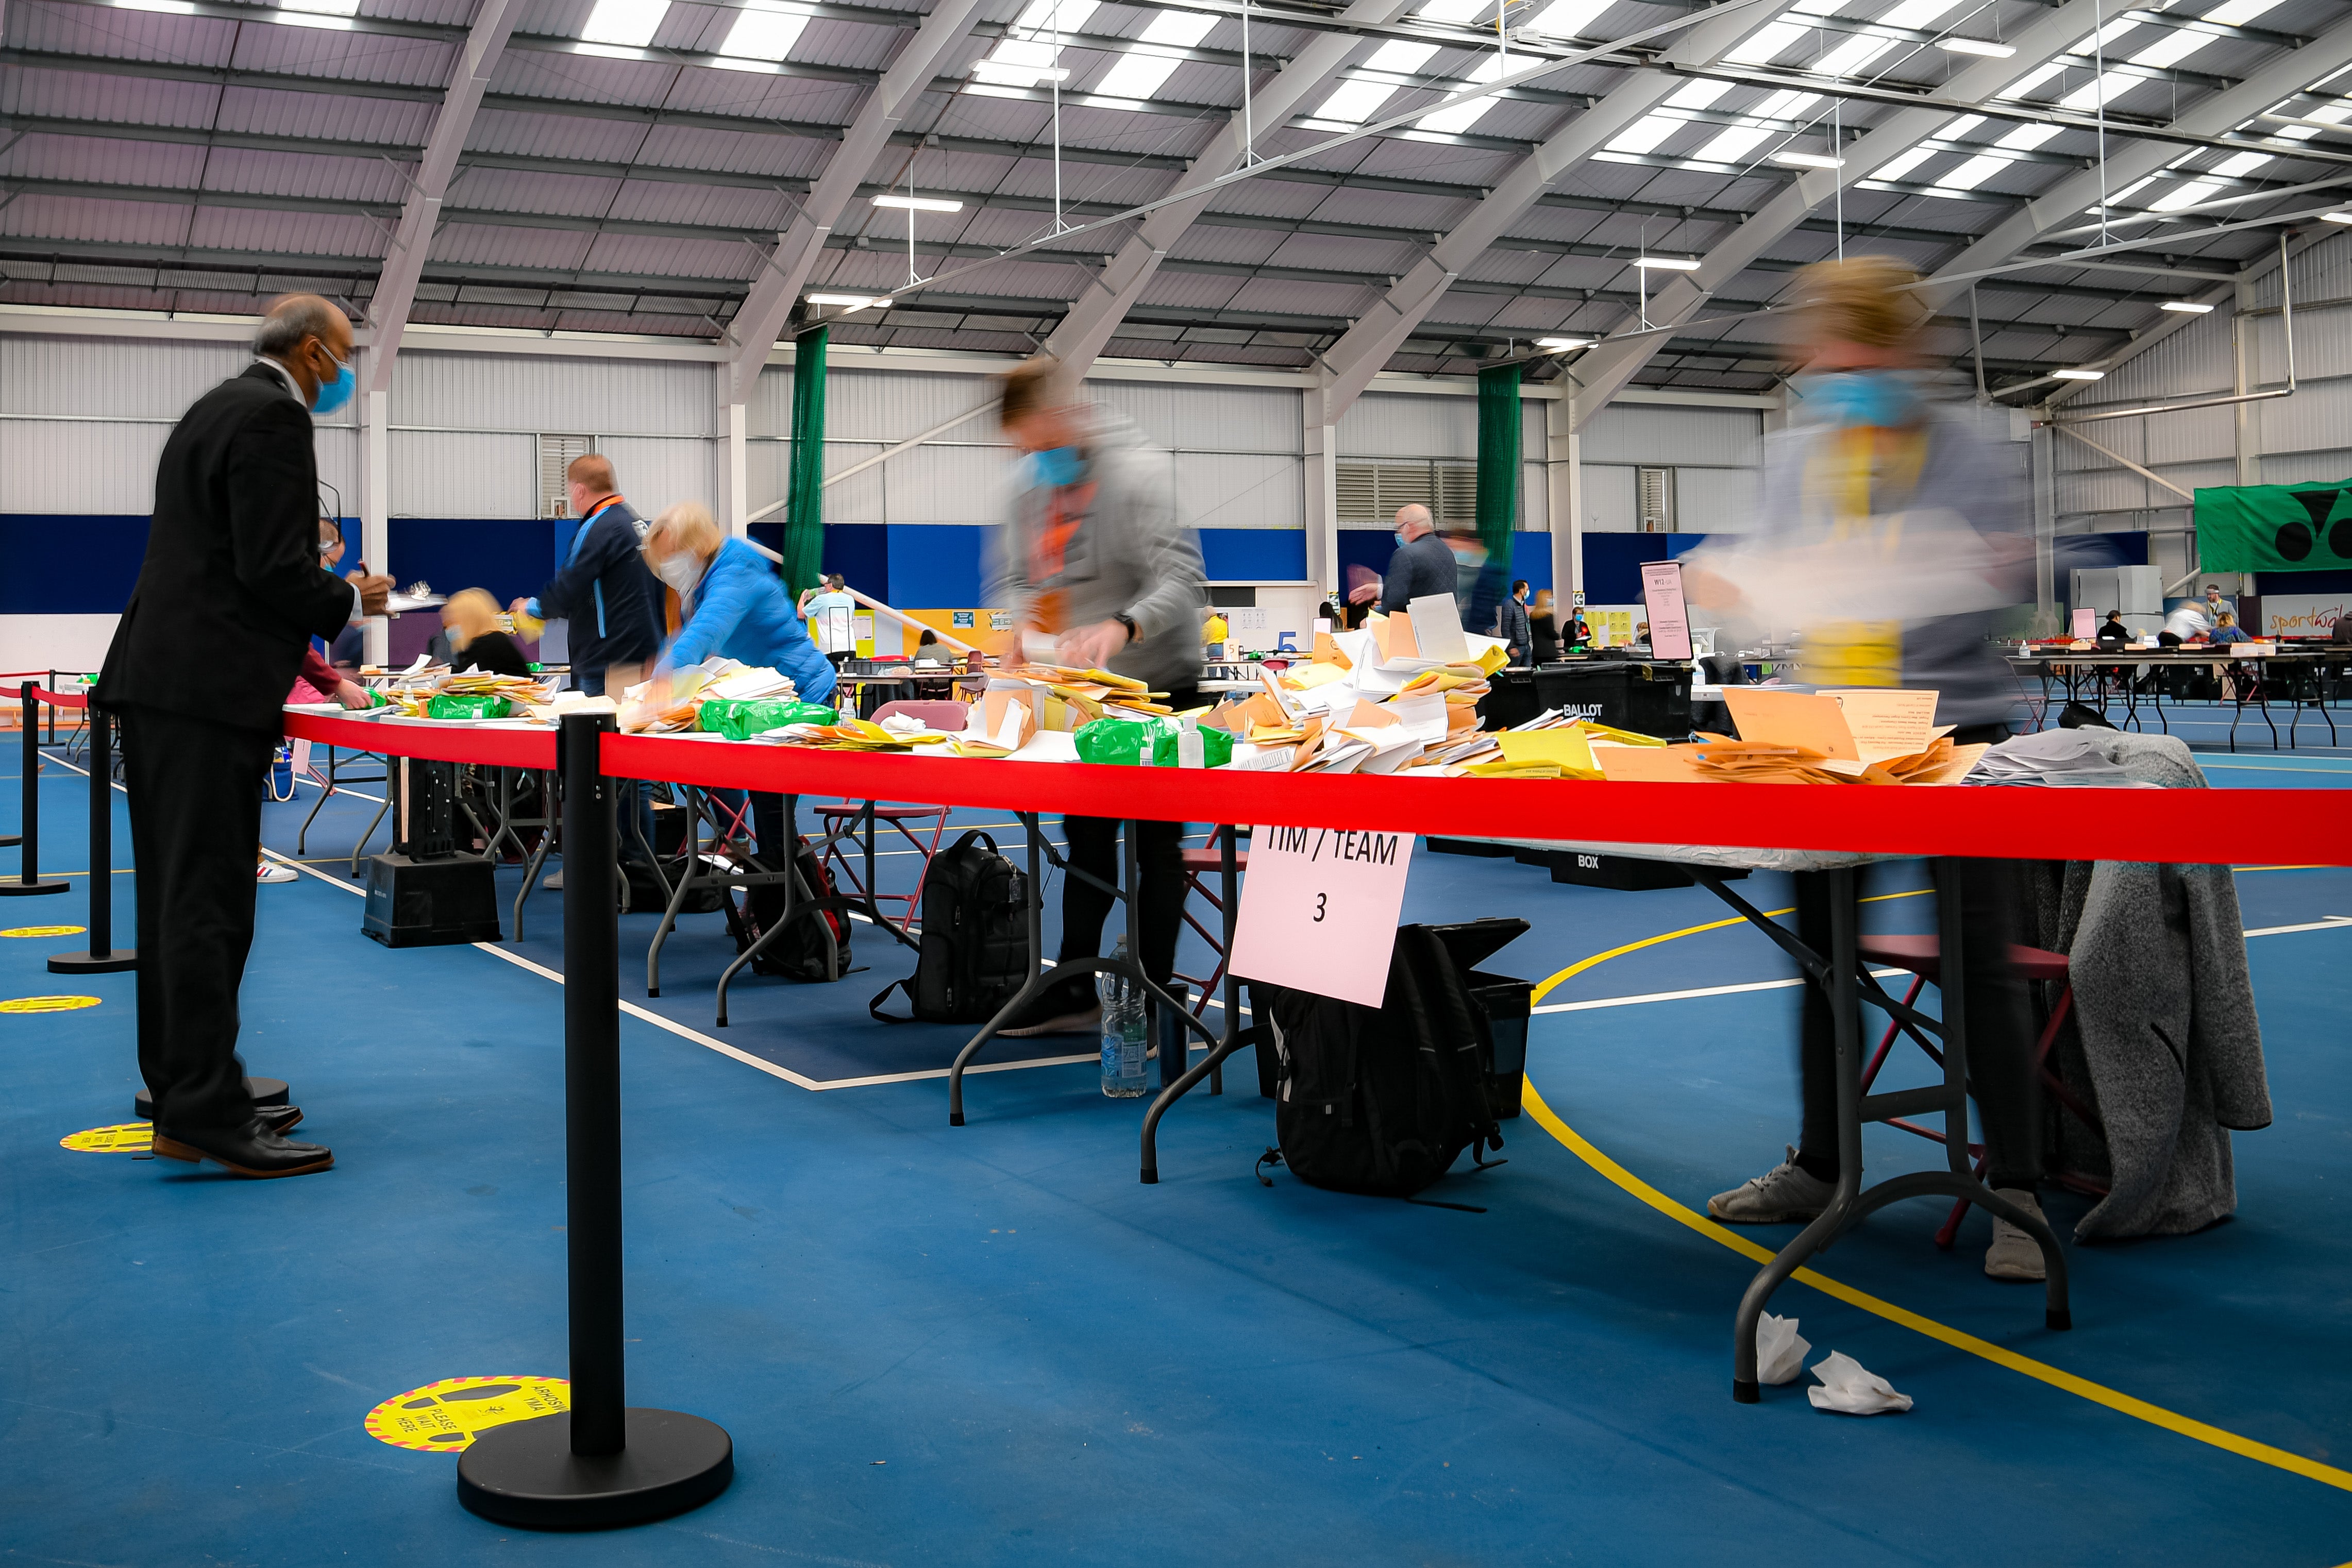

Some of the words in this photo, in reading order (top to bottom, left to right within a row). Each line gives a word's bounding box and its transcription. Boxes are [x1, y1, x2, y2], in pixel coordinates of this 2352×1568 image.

[2270, 604, 2343, 635] sportwal
[1564, 704, 1603, 716] BALLOT
[1334, 830, 1398, 866] TEAM
[1578, 854, 1599, 869] BOX
[1313, 892, 1327, 922] 3
[524, 1397, 546, 1412] YMA
[531, 1386, 570, 1413] ARHOSW
[395, 1417, 419, 1433] HERE
[414, 1414, 436, 1430] WAIT
[428, 1408, 458, 1431] PLEASE
